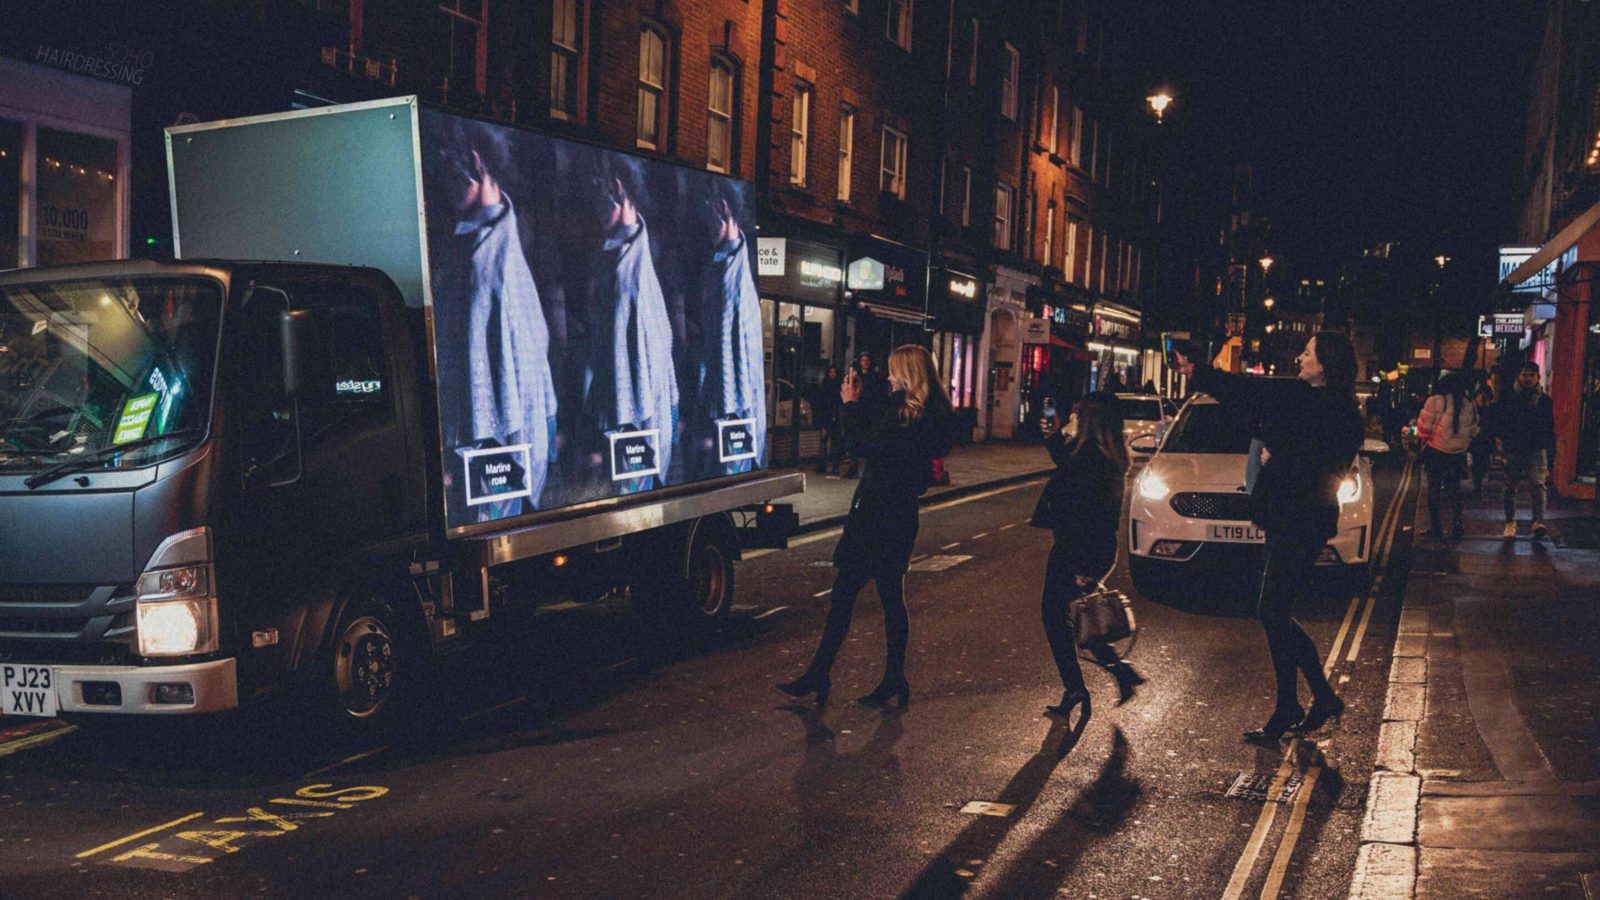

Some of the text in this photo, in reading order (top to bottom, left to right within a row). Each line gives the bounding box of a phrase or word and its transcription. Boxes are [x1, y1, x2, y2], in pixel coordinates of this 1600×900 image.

[105, 41, 154, 69] SOHO
[36, 45, 145, 85] HAIRDRESSING
[771, 248, 778, 256] &
[1495, 324, 1523, 333] MEXICAN
[730, 430, 746, 440] Martine
[625, 444, 645, 455] Martine
[630, 455, 642, 464] rose
[485, 462, 511, 475] Martine
[491, 475, 507, 486] rose
[1214, 526, 1243, 539] LT19
[4, 667, 51, 689] PJ23
[12, 690, 46, 713] XVY
[111, 783, 389, 864] TAXIS
